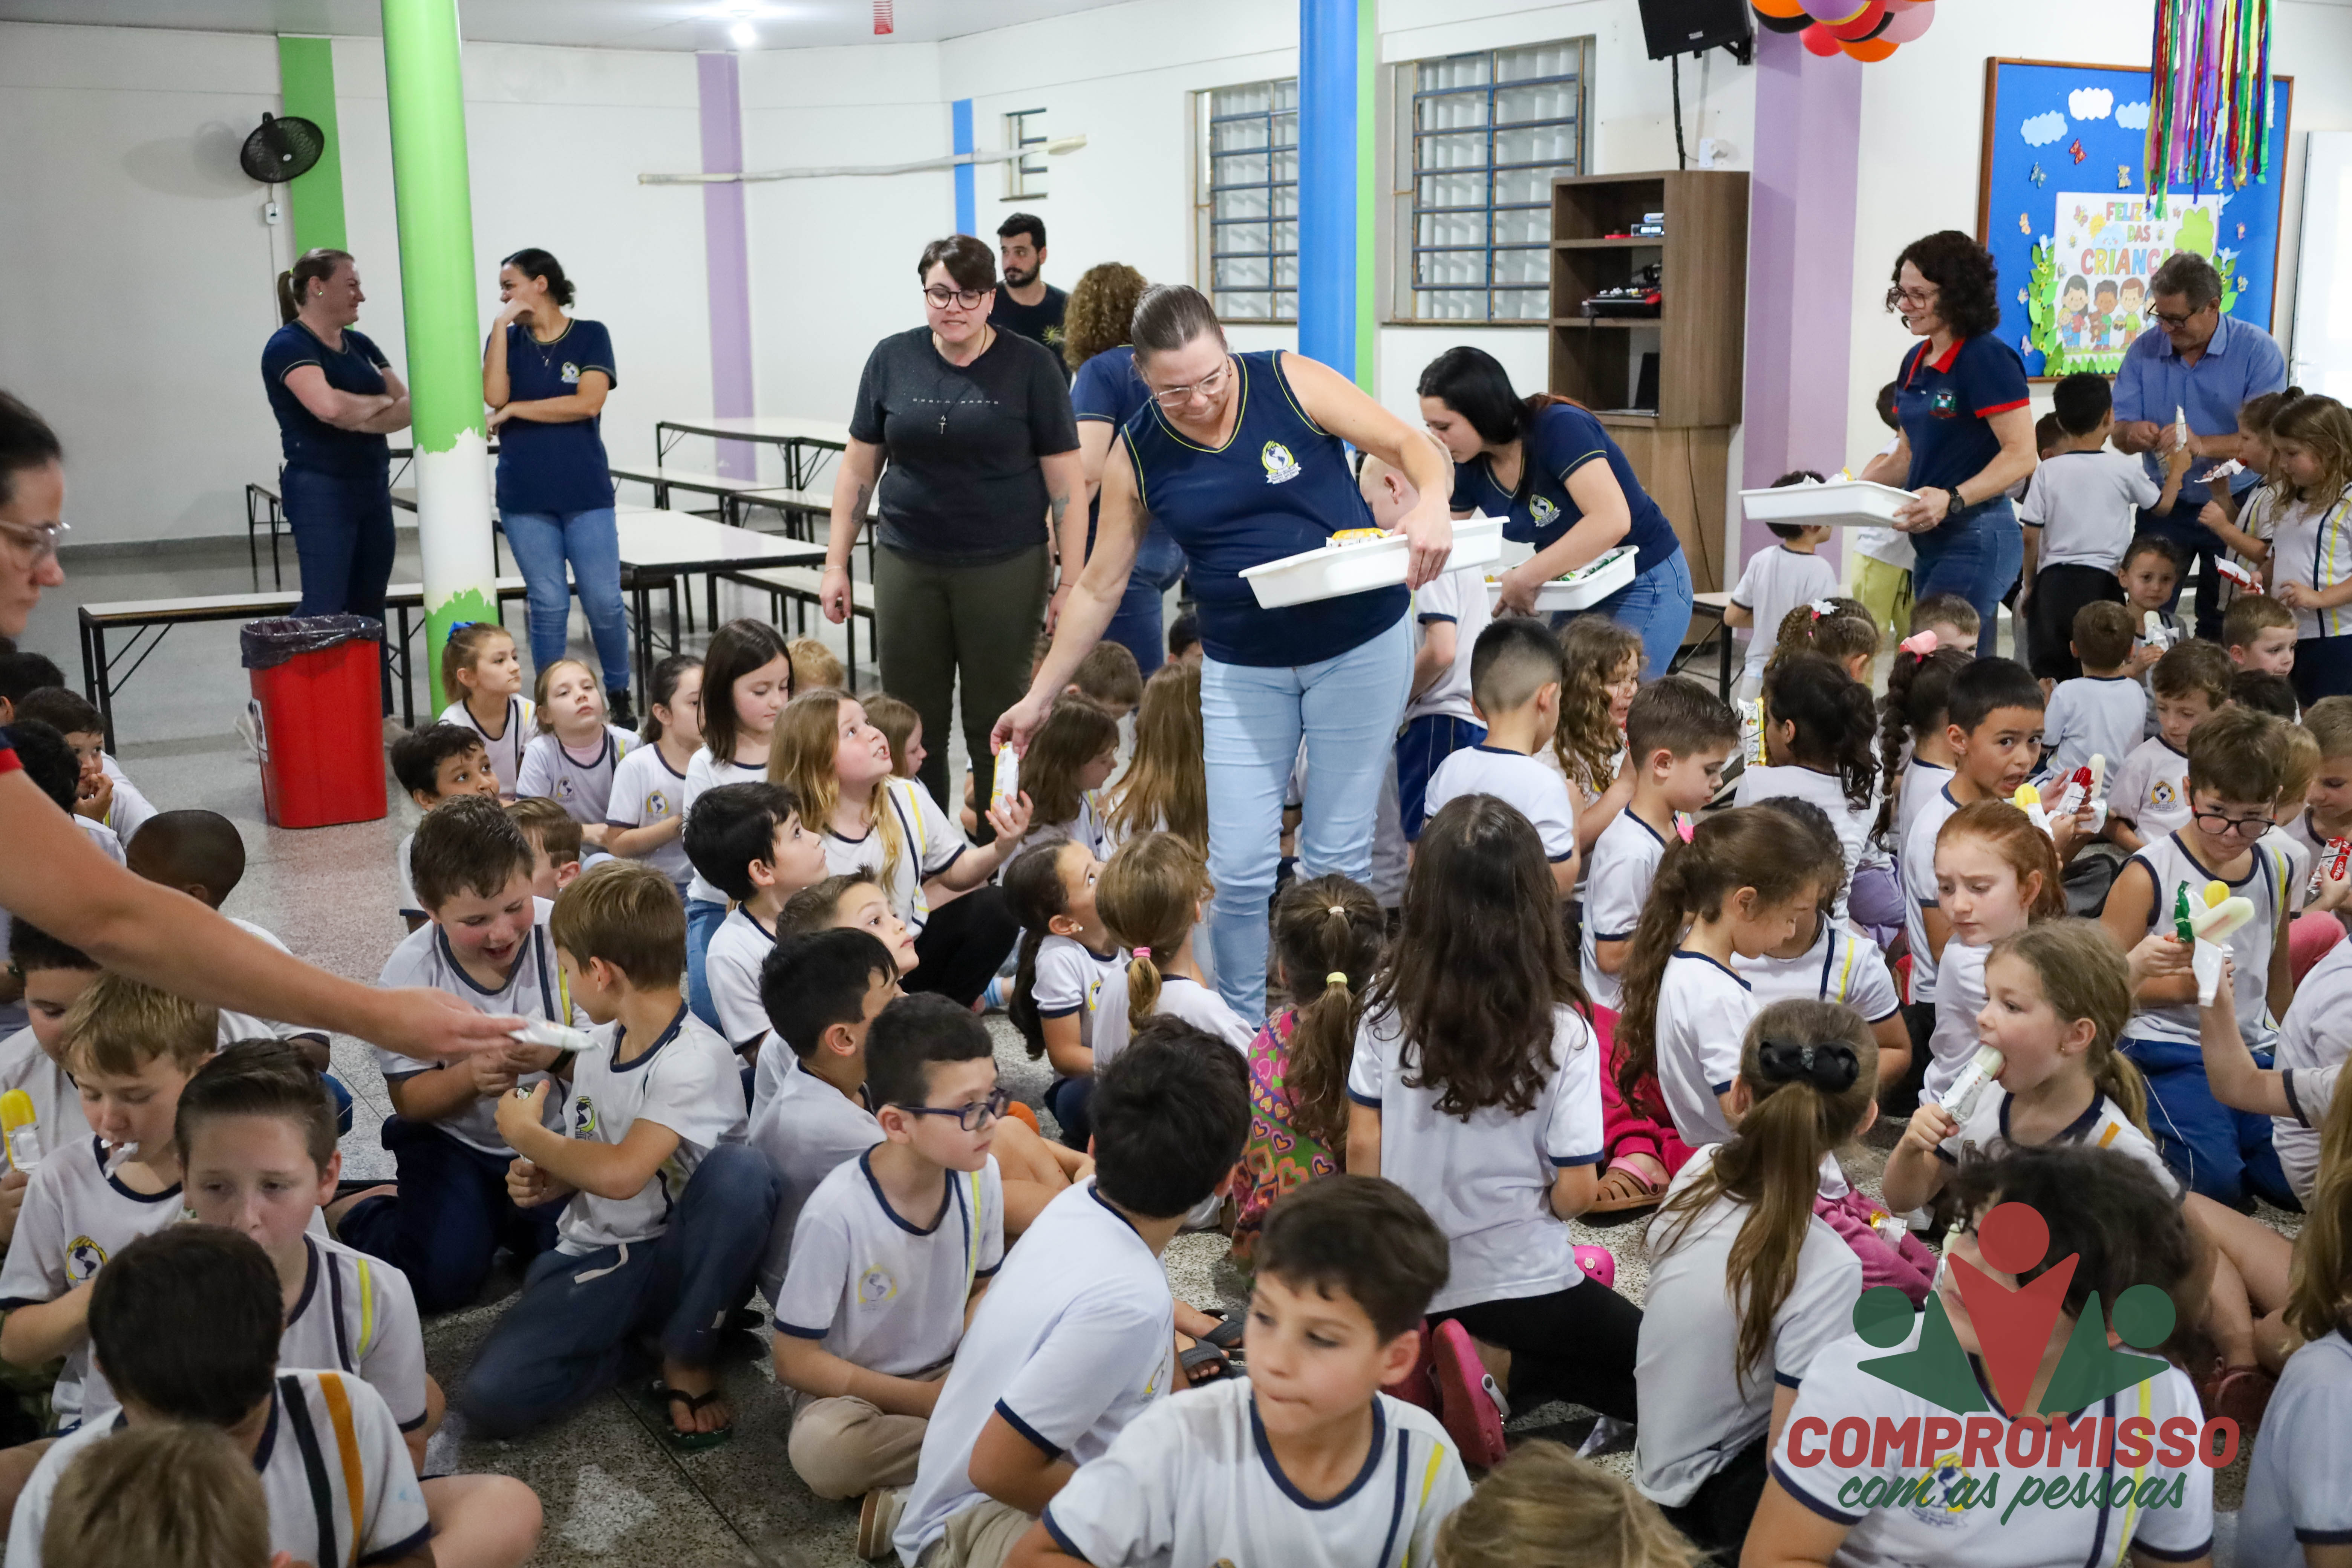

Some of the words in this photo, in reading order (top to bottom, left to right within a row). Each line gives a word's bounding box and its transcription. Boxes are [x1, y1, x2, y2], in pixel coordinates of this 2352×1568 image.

[2106, 202, 2143, 221] FELIZ
[2146, 202, 2168, 222] DA
[2127, 225, 2150, 242] DAS
